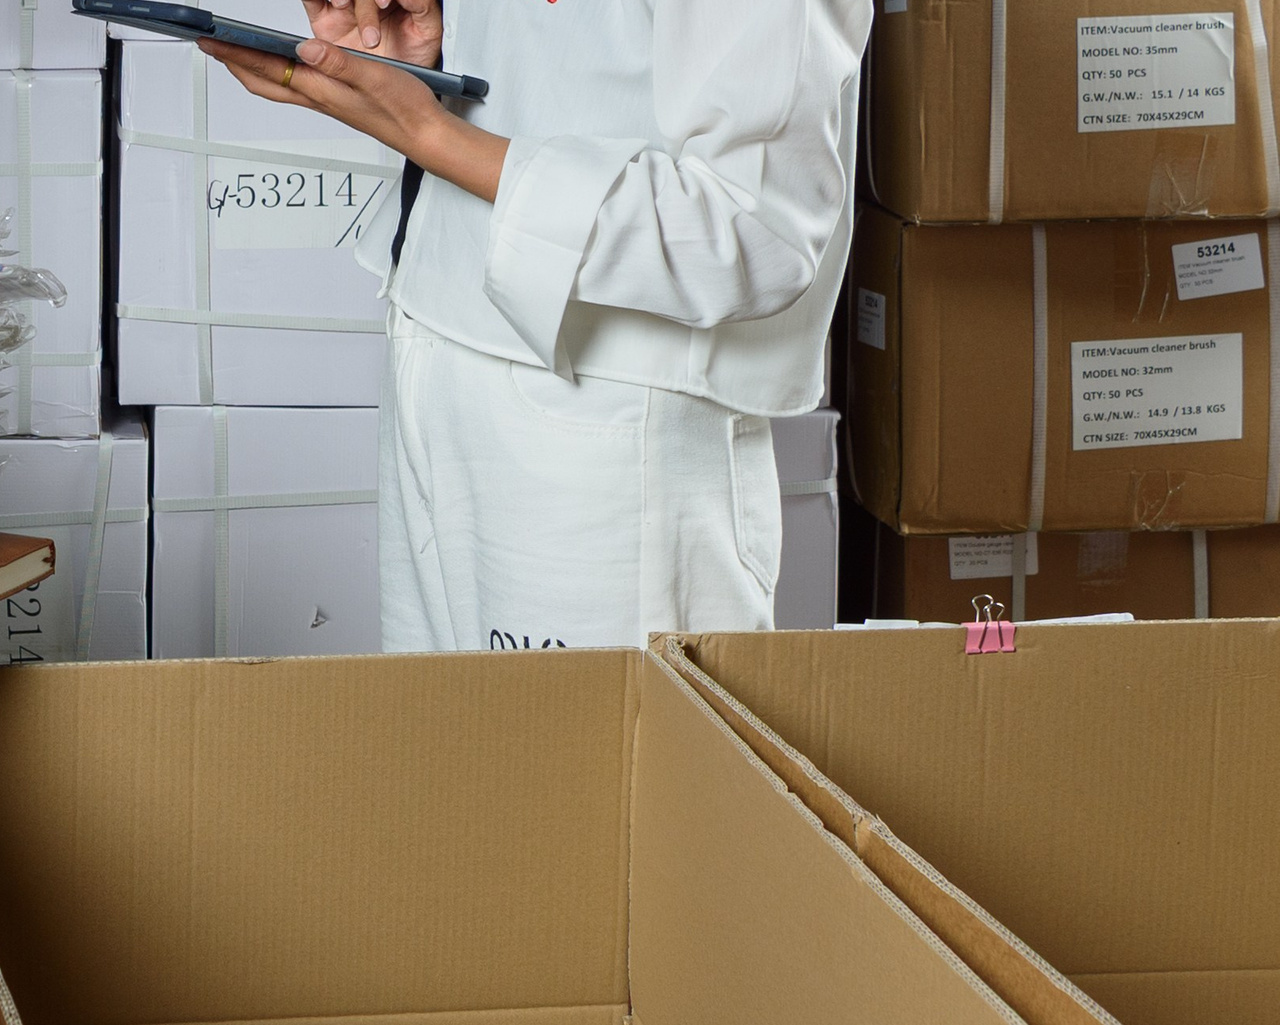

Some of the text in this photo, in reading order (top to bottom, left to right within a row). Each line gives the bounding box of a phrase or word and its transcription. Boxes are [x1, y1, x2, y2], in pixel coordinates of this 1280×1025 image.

[1155, 22, 1193, 33] cleaner
[1195, 20, 1225, 31] brush
[1081, 46, 1178, 58] MODEL NO: 35mm
[1082, 68, 1147, 81] QTY: 50 PCS
[1151, 89, 1173, 100] 15.1
[1187, 88, 1199, 98] 14
[1205, 87, 1225, 97] KGS
[1082, 110, 1204, 125] CTN SIZE: 70X45X29CM
[1197, 242, 1235, 258] 53214
[1151, 343, 1187, 354] cleaner
[1189, 340, 1216, 351] brush
[1082, 365, 1173, 379] MODEL NO: 32mm
[1083, 388, 1144, 401] QTY: 50 PCS
[1148, 408, 1169, 418] 14.9
[1181, 405, 1202, 416] 13.8
[1206, 403, 1226, 413] KGS
[1083, 428, 1197, 443] CTN SIZE: 70X45X29CM
